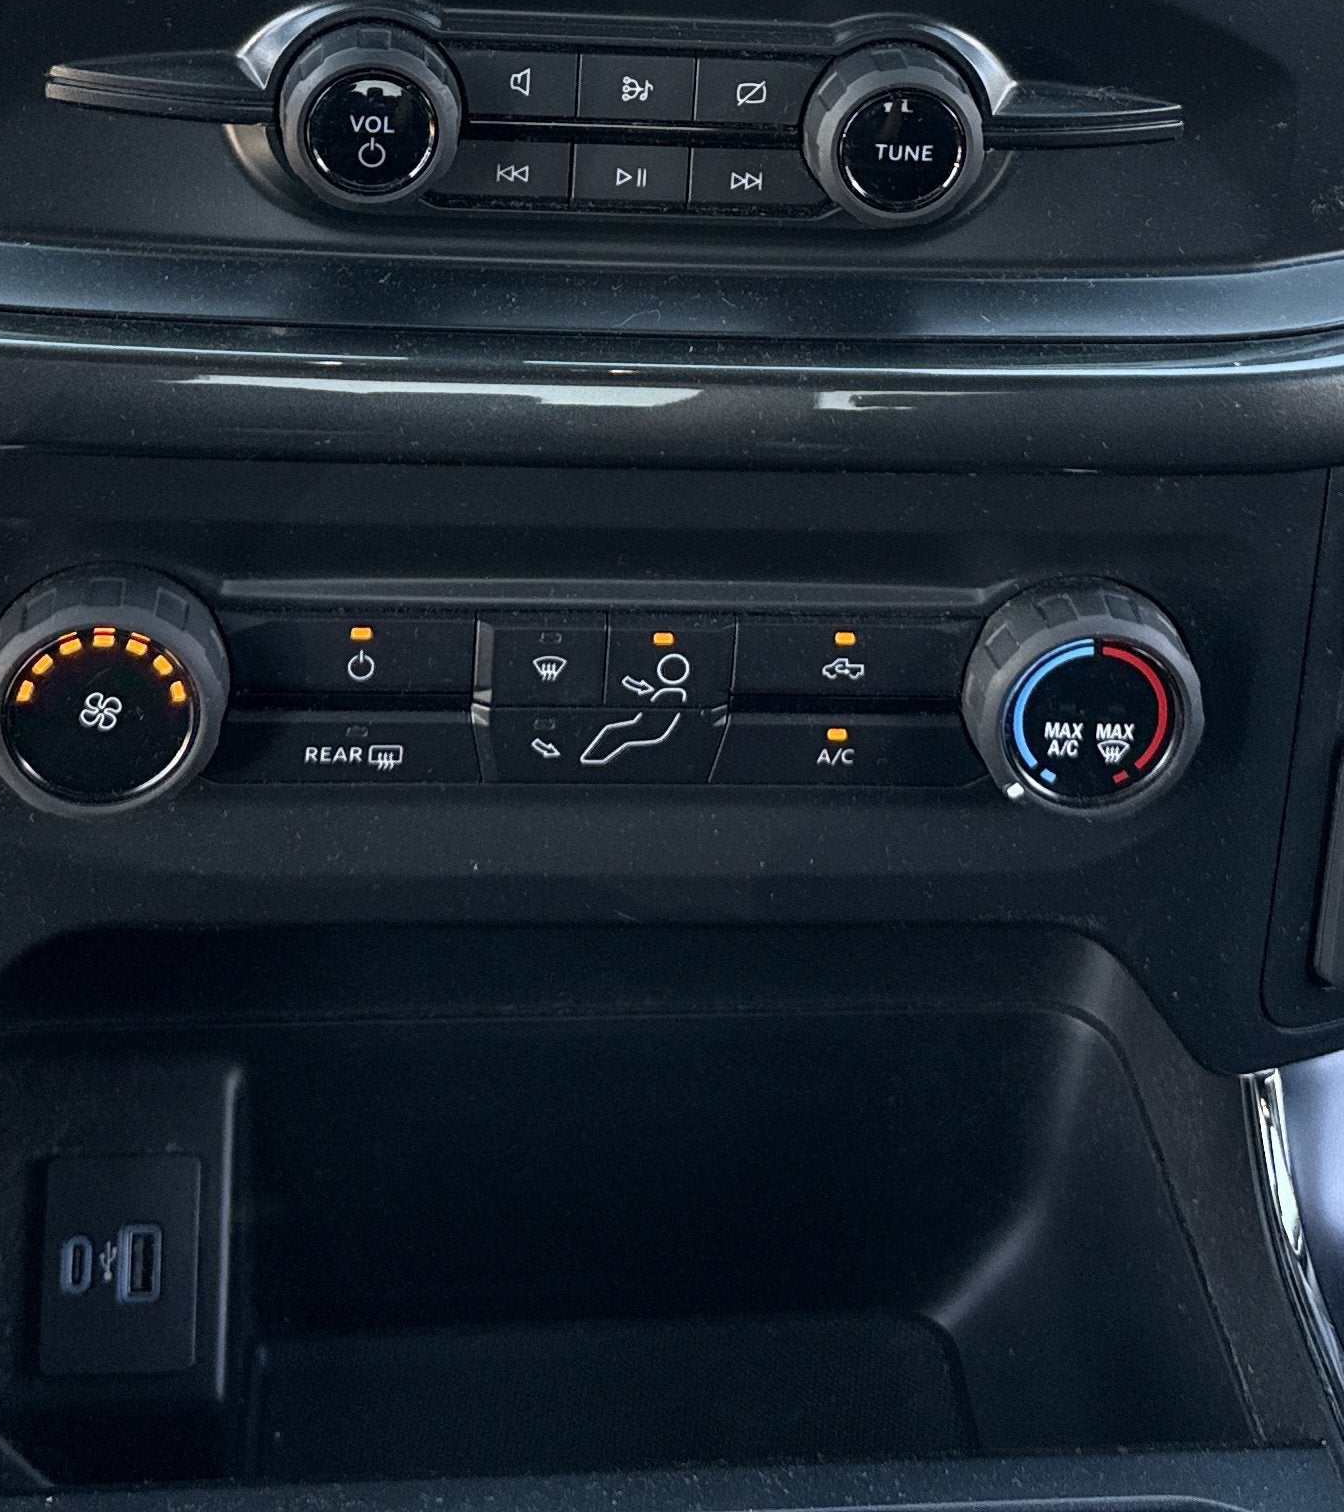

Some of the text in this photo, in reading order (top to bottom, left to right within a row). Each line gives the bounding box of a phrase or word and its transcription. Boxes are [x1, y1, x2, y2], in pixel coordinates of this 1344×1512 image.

[349, 114, 395, 134] VOL
[874, 143, 934, 162] TUNE
[1044, 721, 1084, 740] MAX
[1096, 723, 1134, 741] MAX
[304, 746, 363, 763] REAR
[817, 748, 854, 766] A/C
[1047, 739, 1079, 758] A/C
